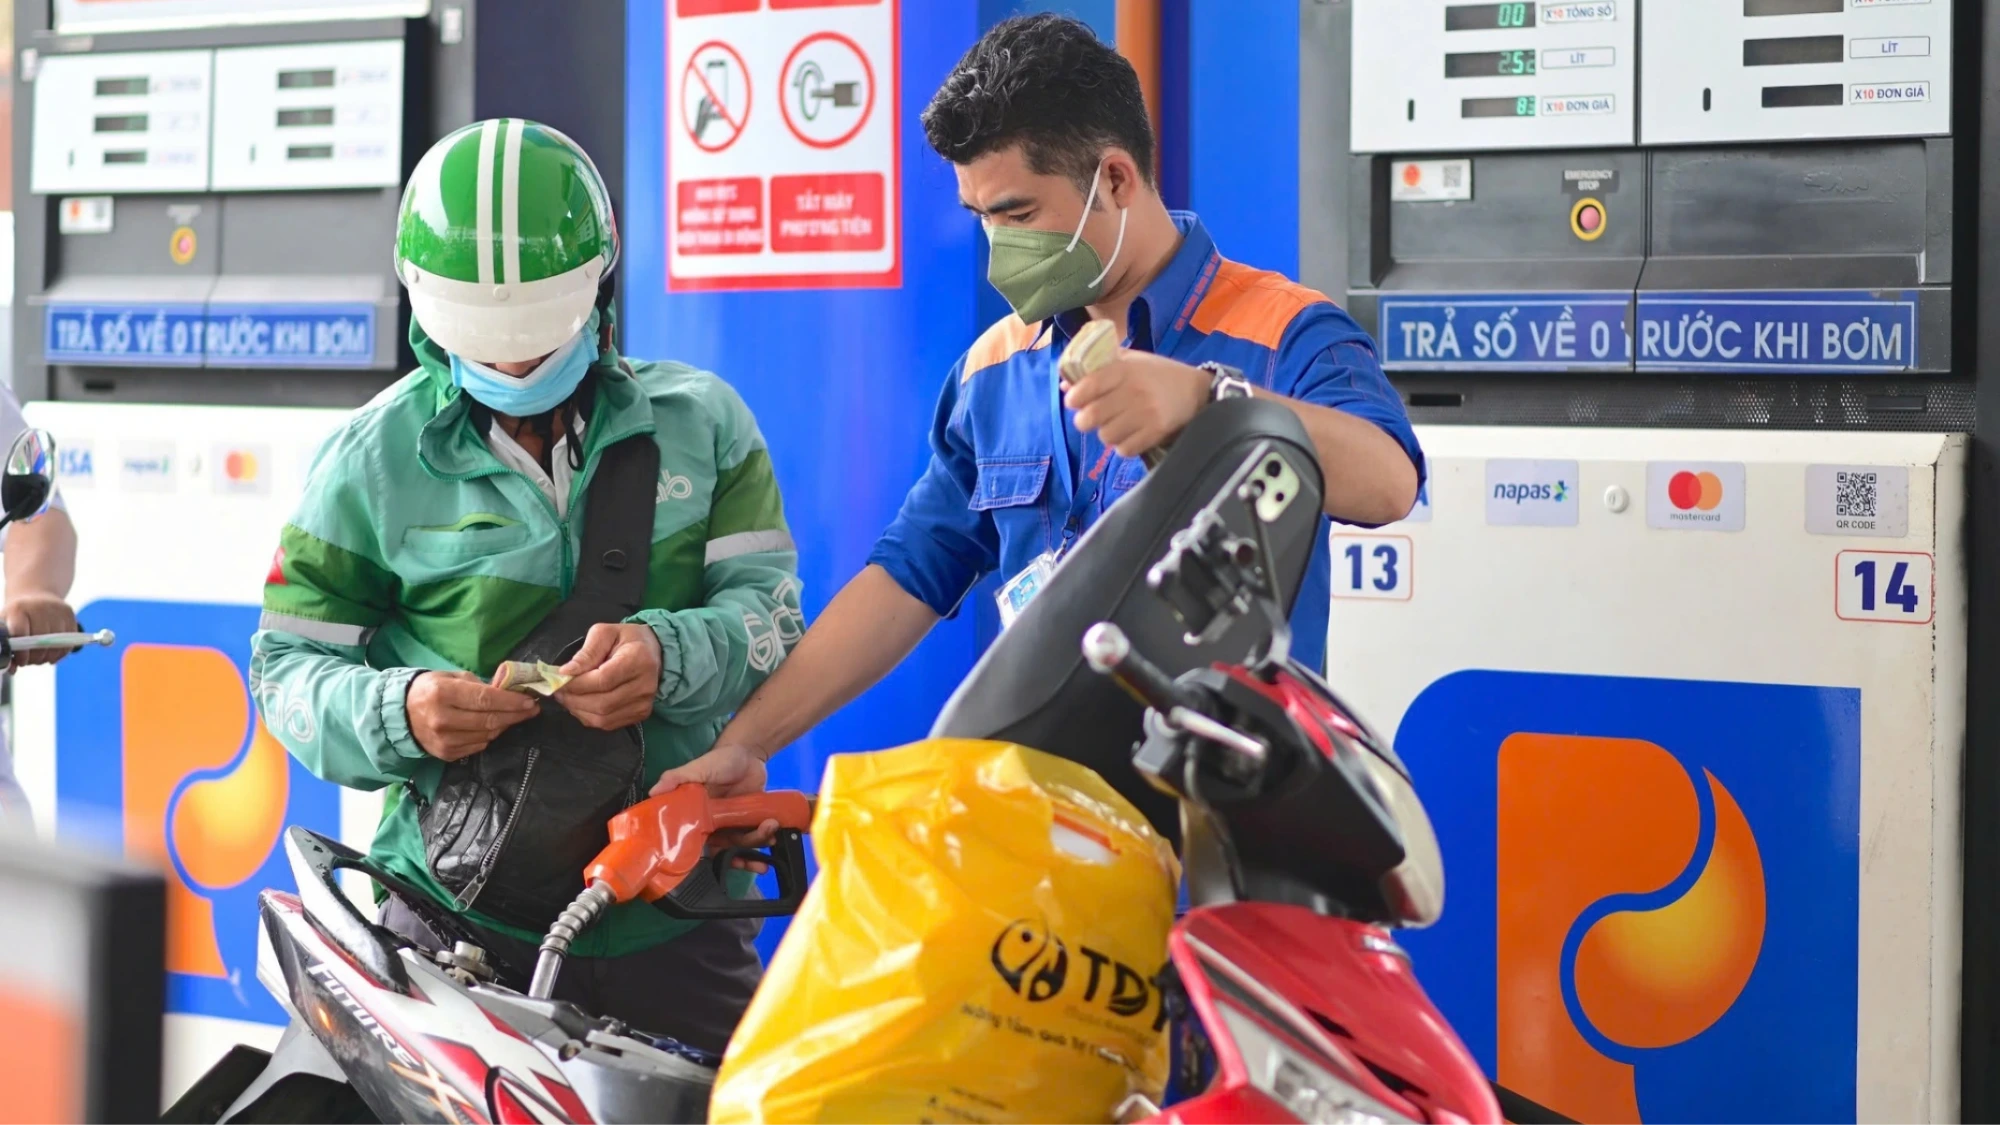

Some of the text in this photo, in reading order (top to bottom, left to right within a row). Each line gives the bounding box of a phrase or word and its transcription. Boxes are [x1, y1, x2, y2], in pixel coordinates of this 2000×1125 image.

[1881, 41, 1898, 54] LÍT
[1570, 53, 1585, 64] LÍT
[1855, 85, 1924, 99] X10 ĐƠN GIÁ
[1564, 170, 1612, 181] EMERGENCY
[1578, 181, 1599, 191] STOP
[273, 321, 311, 352] KHI
[1401, 307, 1461, 358] TRẢ
[1473, 307, 1519, 358] SỐ
[1530, 305, 1576, 357] VỀ
[1754, 321, 1808, 359] KHI
[1822, 317, 1902, 360] BƠM
[60, 449, 93, 476] ISA
[1494, 480, 1551, 504] napas
[1670, 513, 1721, 523] mastercard
[1836, 520, 1876, 530] QR CODE
[1345, 544, 1398, 591] 13
[1855, 561, 1918, 613] 14
[308, 962, 423, 1070] FUTURE
